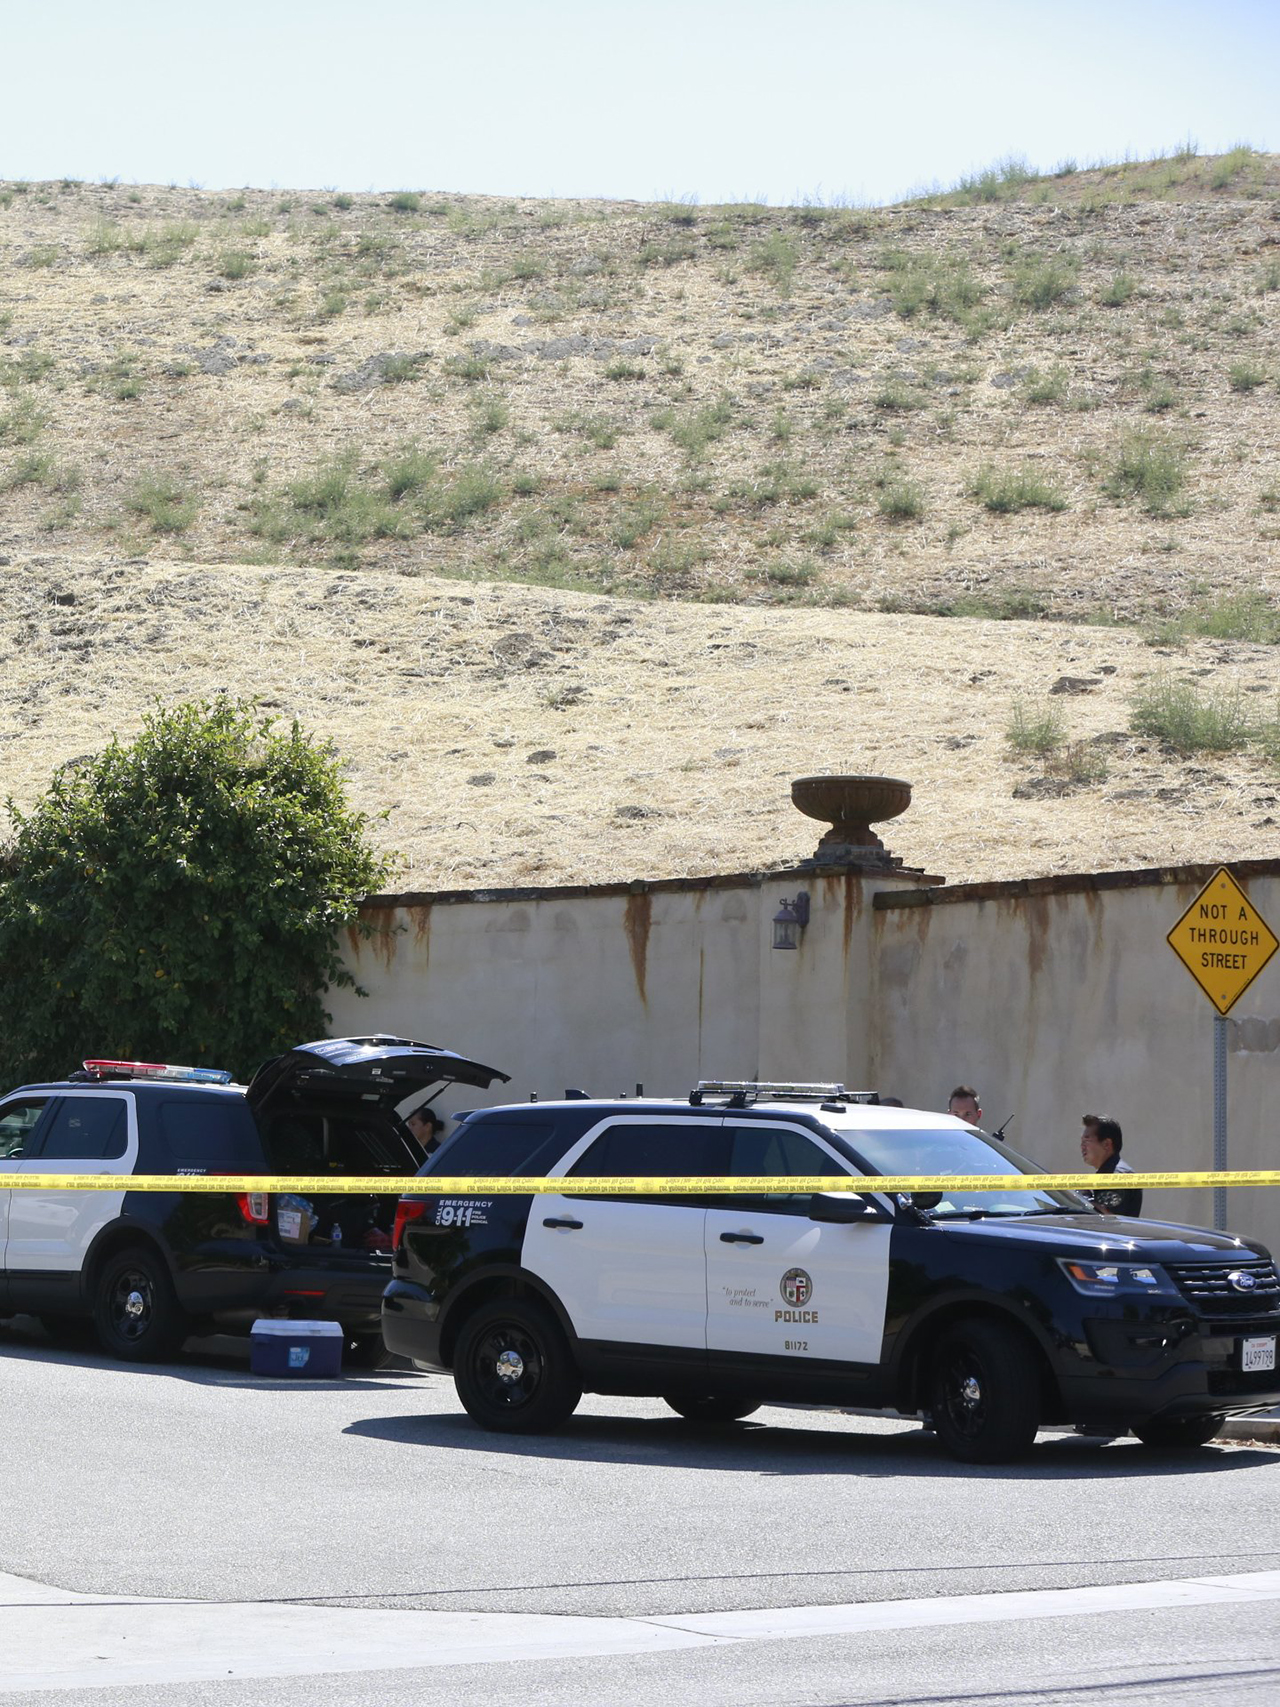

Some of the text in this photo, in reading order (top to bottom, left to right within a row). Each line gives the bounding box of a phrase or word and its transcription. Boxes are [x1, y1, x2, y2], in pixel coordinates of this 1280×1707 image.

[1200, 904, 1248, 920] NOT A
[1189, 928, 1259, 946] THROUGH
[1201, 952, 1248, 970] STREET
[435, 1206, 443, 1225] CALL
[733, 1288, 756, 1297] protect
[730, 1298, 742, 1306] and
[744, 1298, 752, 1306] to
[775, 1310, 818, 1323] POLICE
[785, 1341, 808, 1350] 81172
[1245, 1350, 1273, 1366] 1499798
